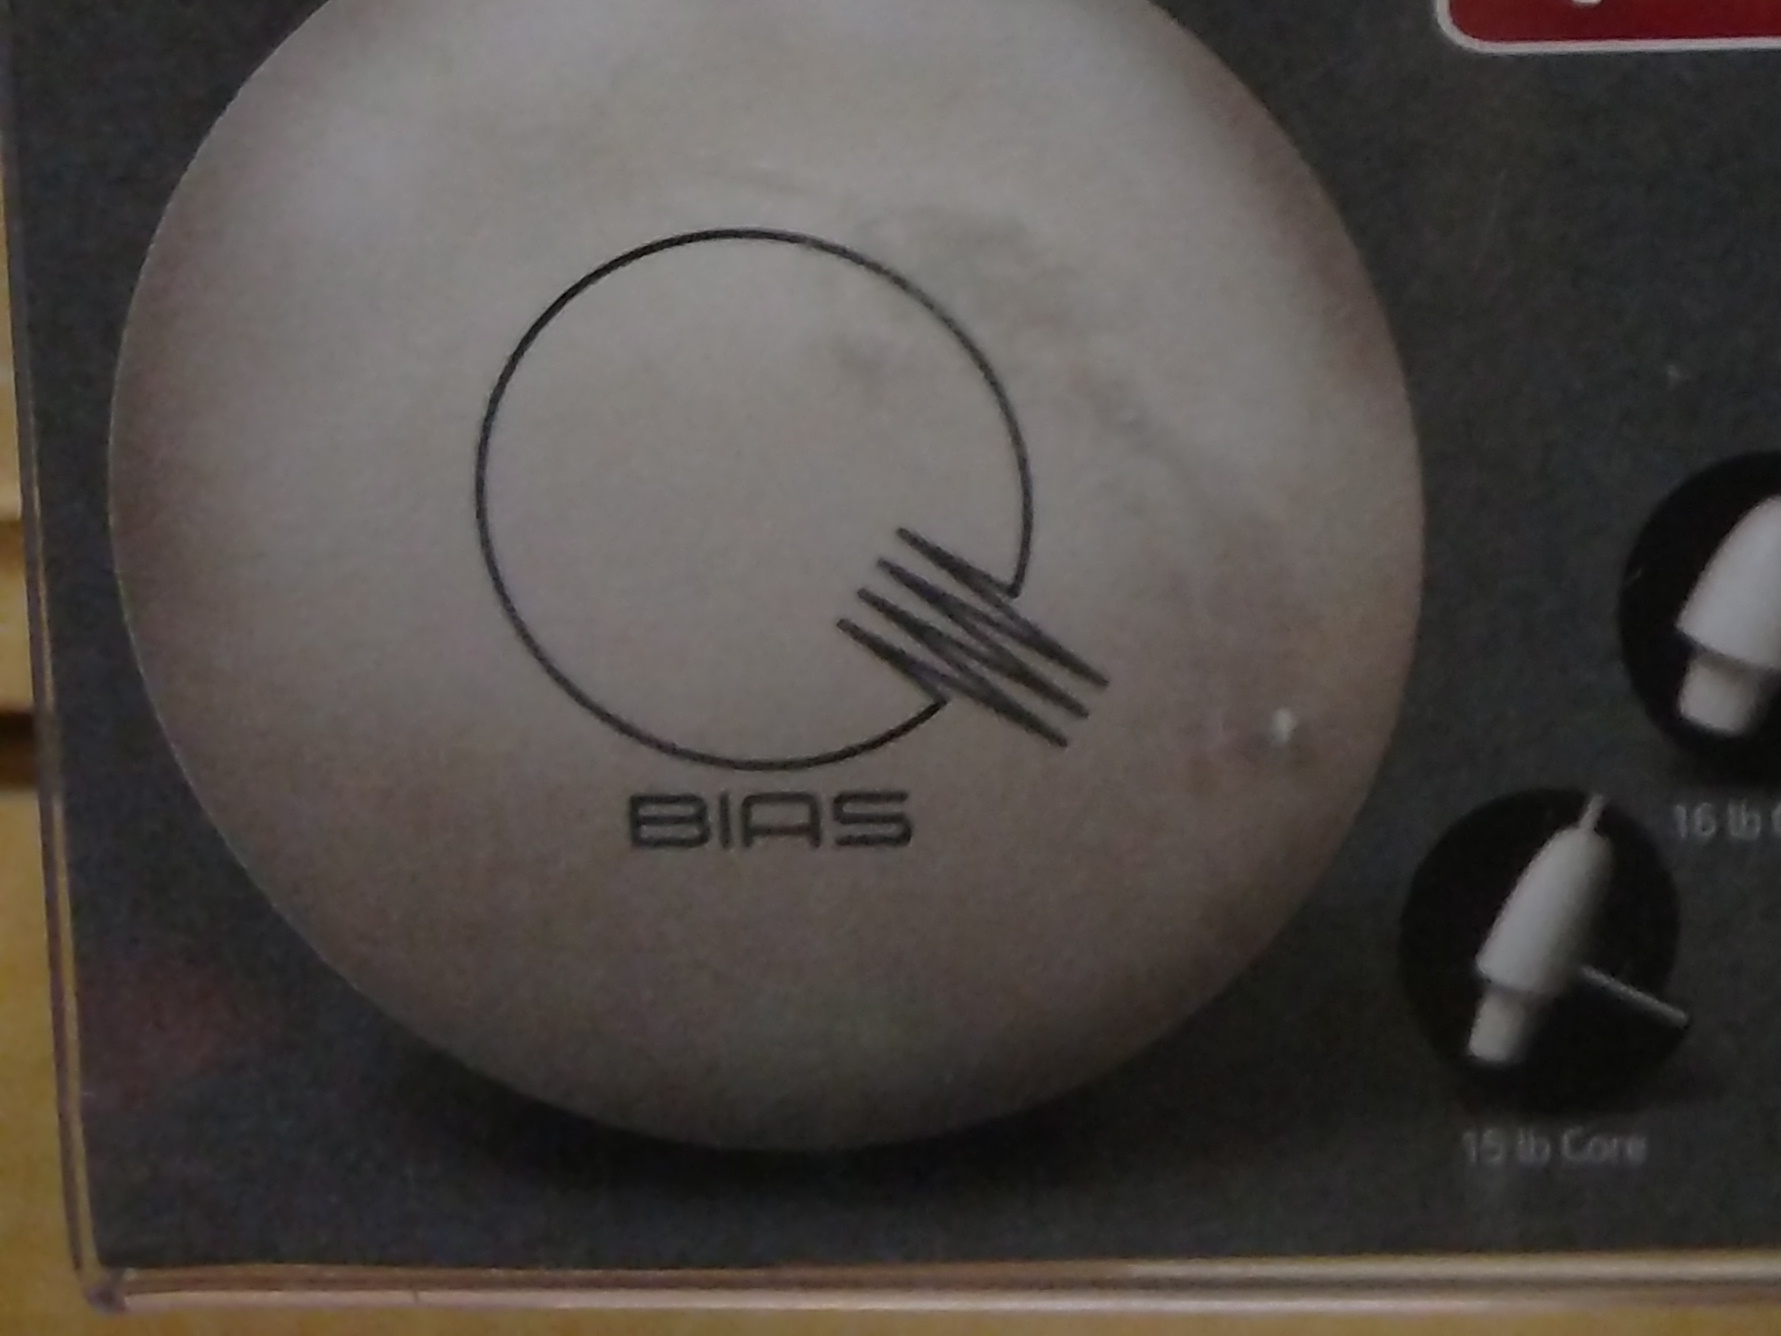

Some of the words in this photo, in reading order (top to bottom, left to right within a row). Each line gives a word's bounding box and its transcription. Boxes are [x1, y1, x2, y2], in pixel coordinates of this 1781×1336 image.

[629, 791, 914, 849] BIAS
[1673, 803, 1715, 839] 16
[1727, 802, 1762, 839] lb
[1463, 1131, 1501, 1166] 15
[1515, 1129, 1550, 1166] lb
[1560, 1129, 1648, 1165] Core
